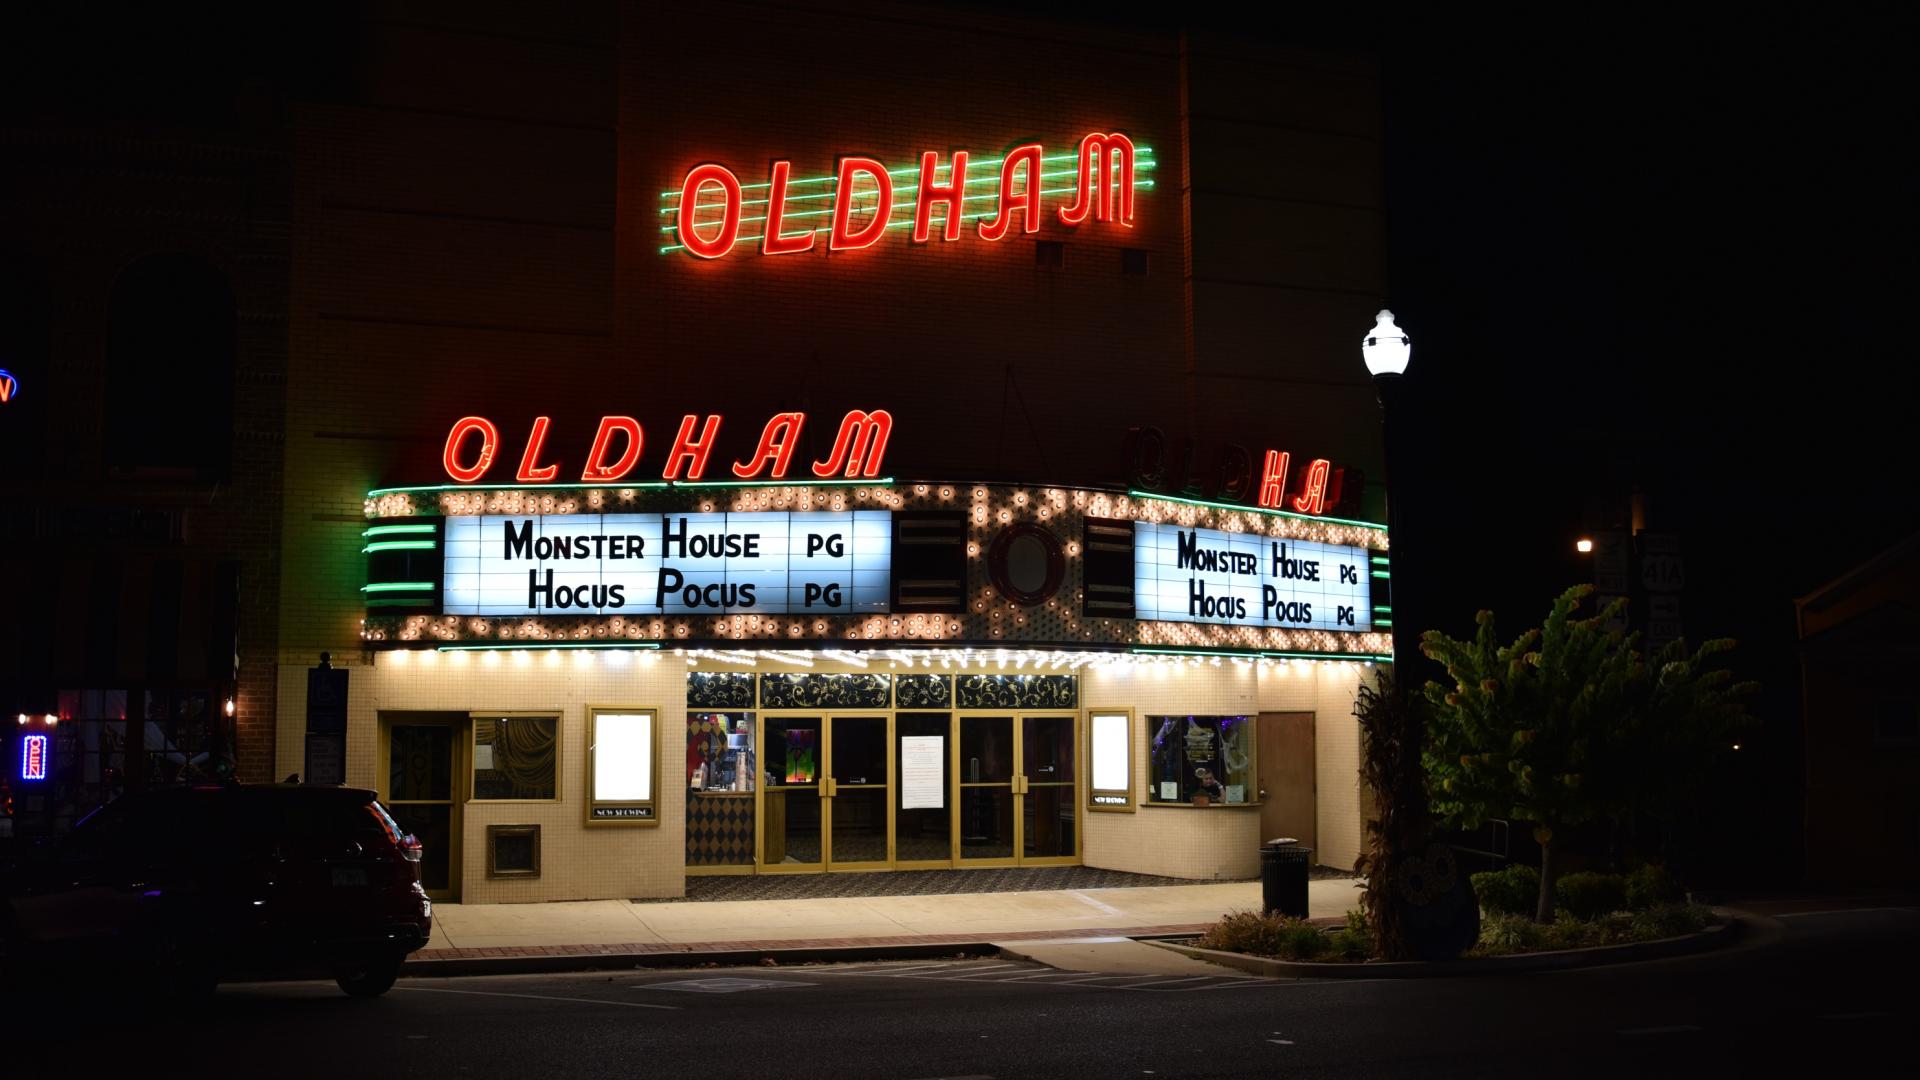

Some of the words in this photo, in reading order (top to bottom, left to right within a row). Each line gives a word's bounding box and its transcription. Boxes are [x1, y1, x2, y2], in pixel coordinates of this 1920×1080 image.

[676, 132, 1135, 259] OLDHAM
[443, 410, 892, 482] OLDHAM
[806, 533, 844, 558] PG
[1340, 564, 1357, 585] PG
[804, 582, 842, 608] PG
[1337, 606, 1355, 626] PG
[29, 737, 41, 776] OPEN
